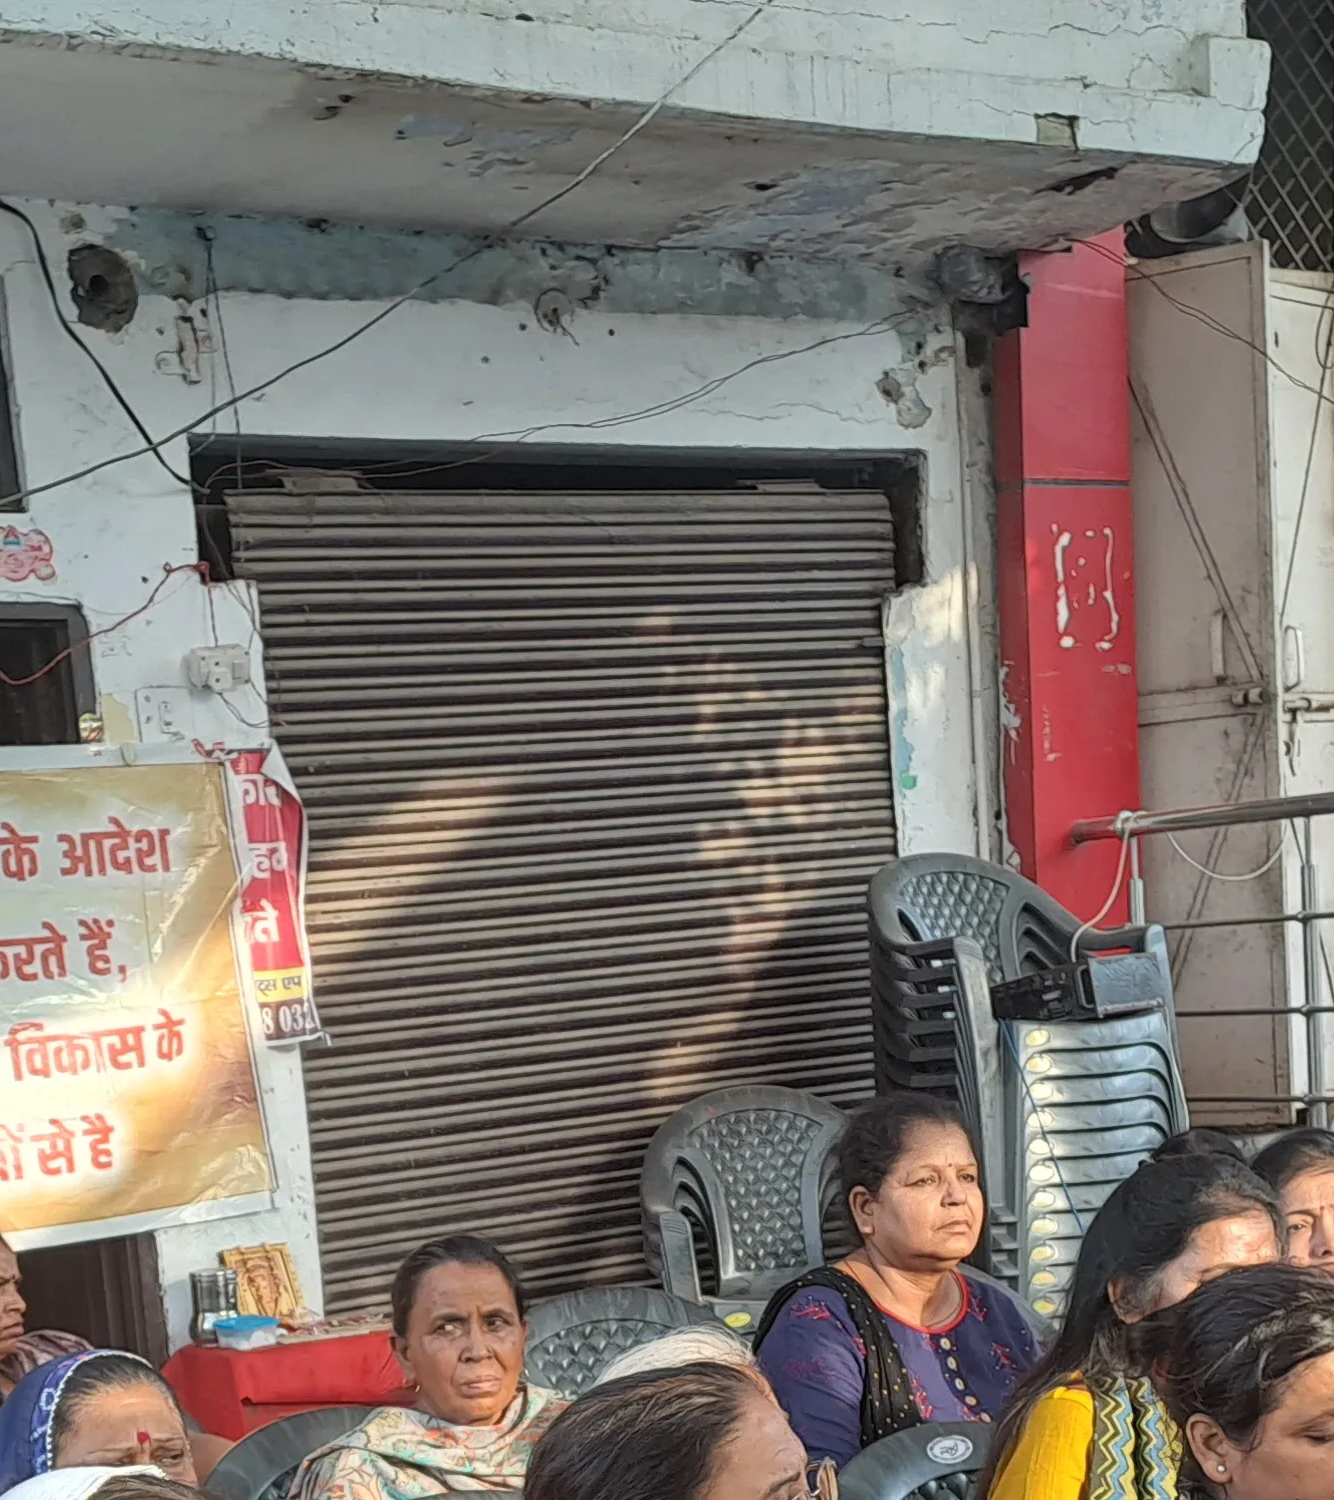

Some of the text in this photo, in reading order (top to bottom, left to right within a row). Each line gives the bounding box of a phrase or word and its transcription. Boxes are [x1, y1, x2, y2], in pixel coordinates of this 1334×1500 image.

[57, 816, 171, 878] आदेश
[78, 918, 127, 983] हैं,
[6, 1022, 146, 1082] विकास
[152, 1008, 185, 1062] के
[30, 1118, 76, 1176] से
[79, 1113, 115, 1171] है
